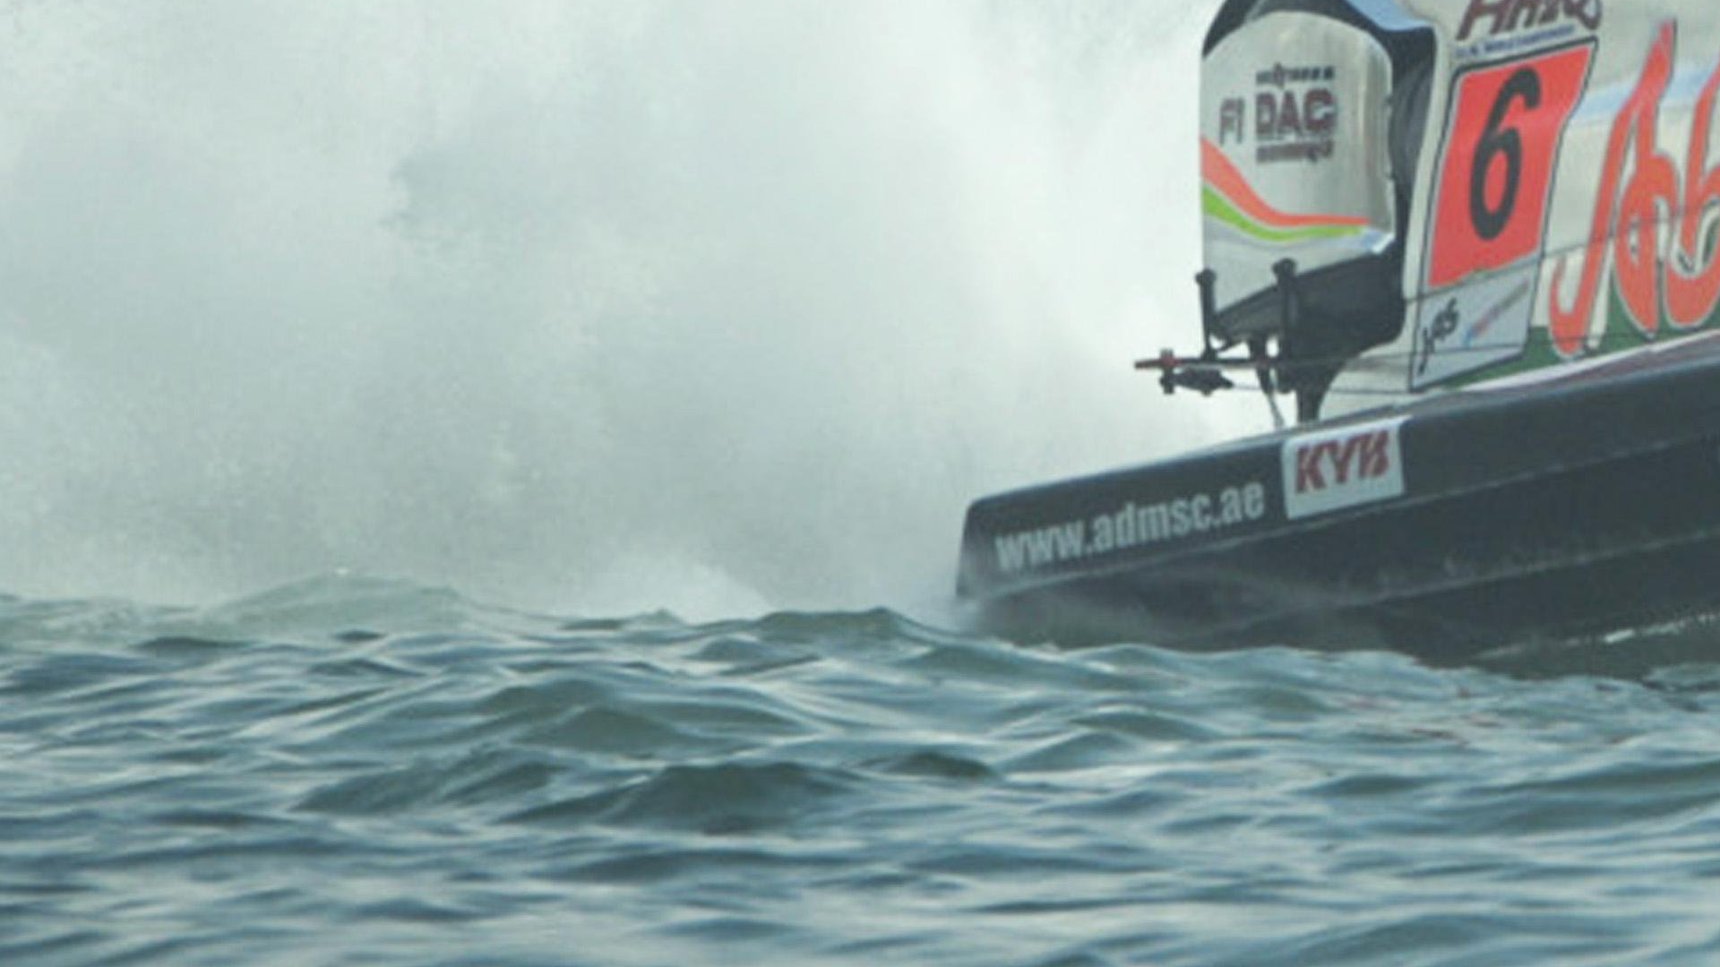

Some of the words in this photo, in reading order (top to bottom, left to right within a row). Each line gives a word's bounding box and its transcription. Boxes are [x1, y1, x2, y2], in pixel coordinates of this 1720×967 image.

[1469, 66, 1542, 242] 6
[1294, 429, 1391, 495] KYB
[993, 480, 1266, 574] www.admsc.ae
